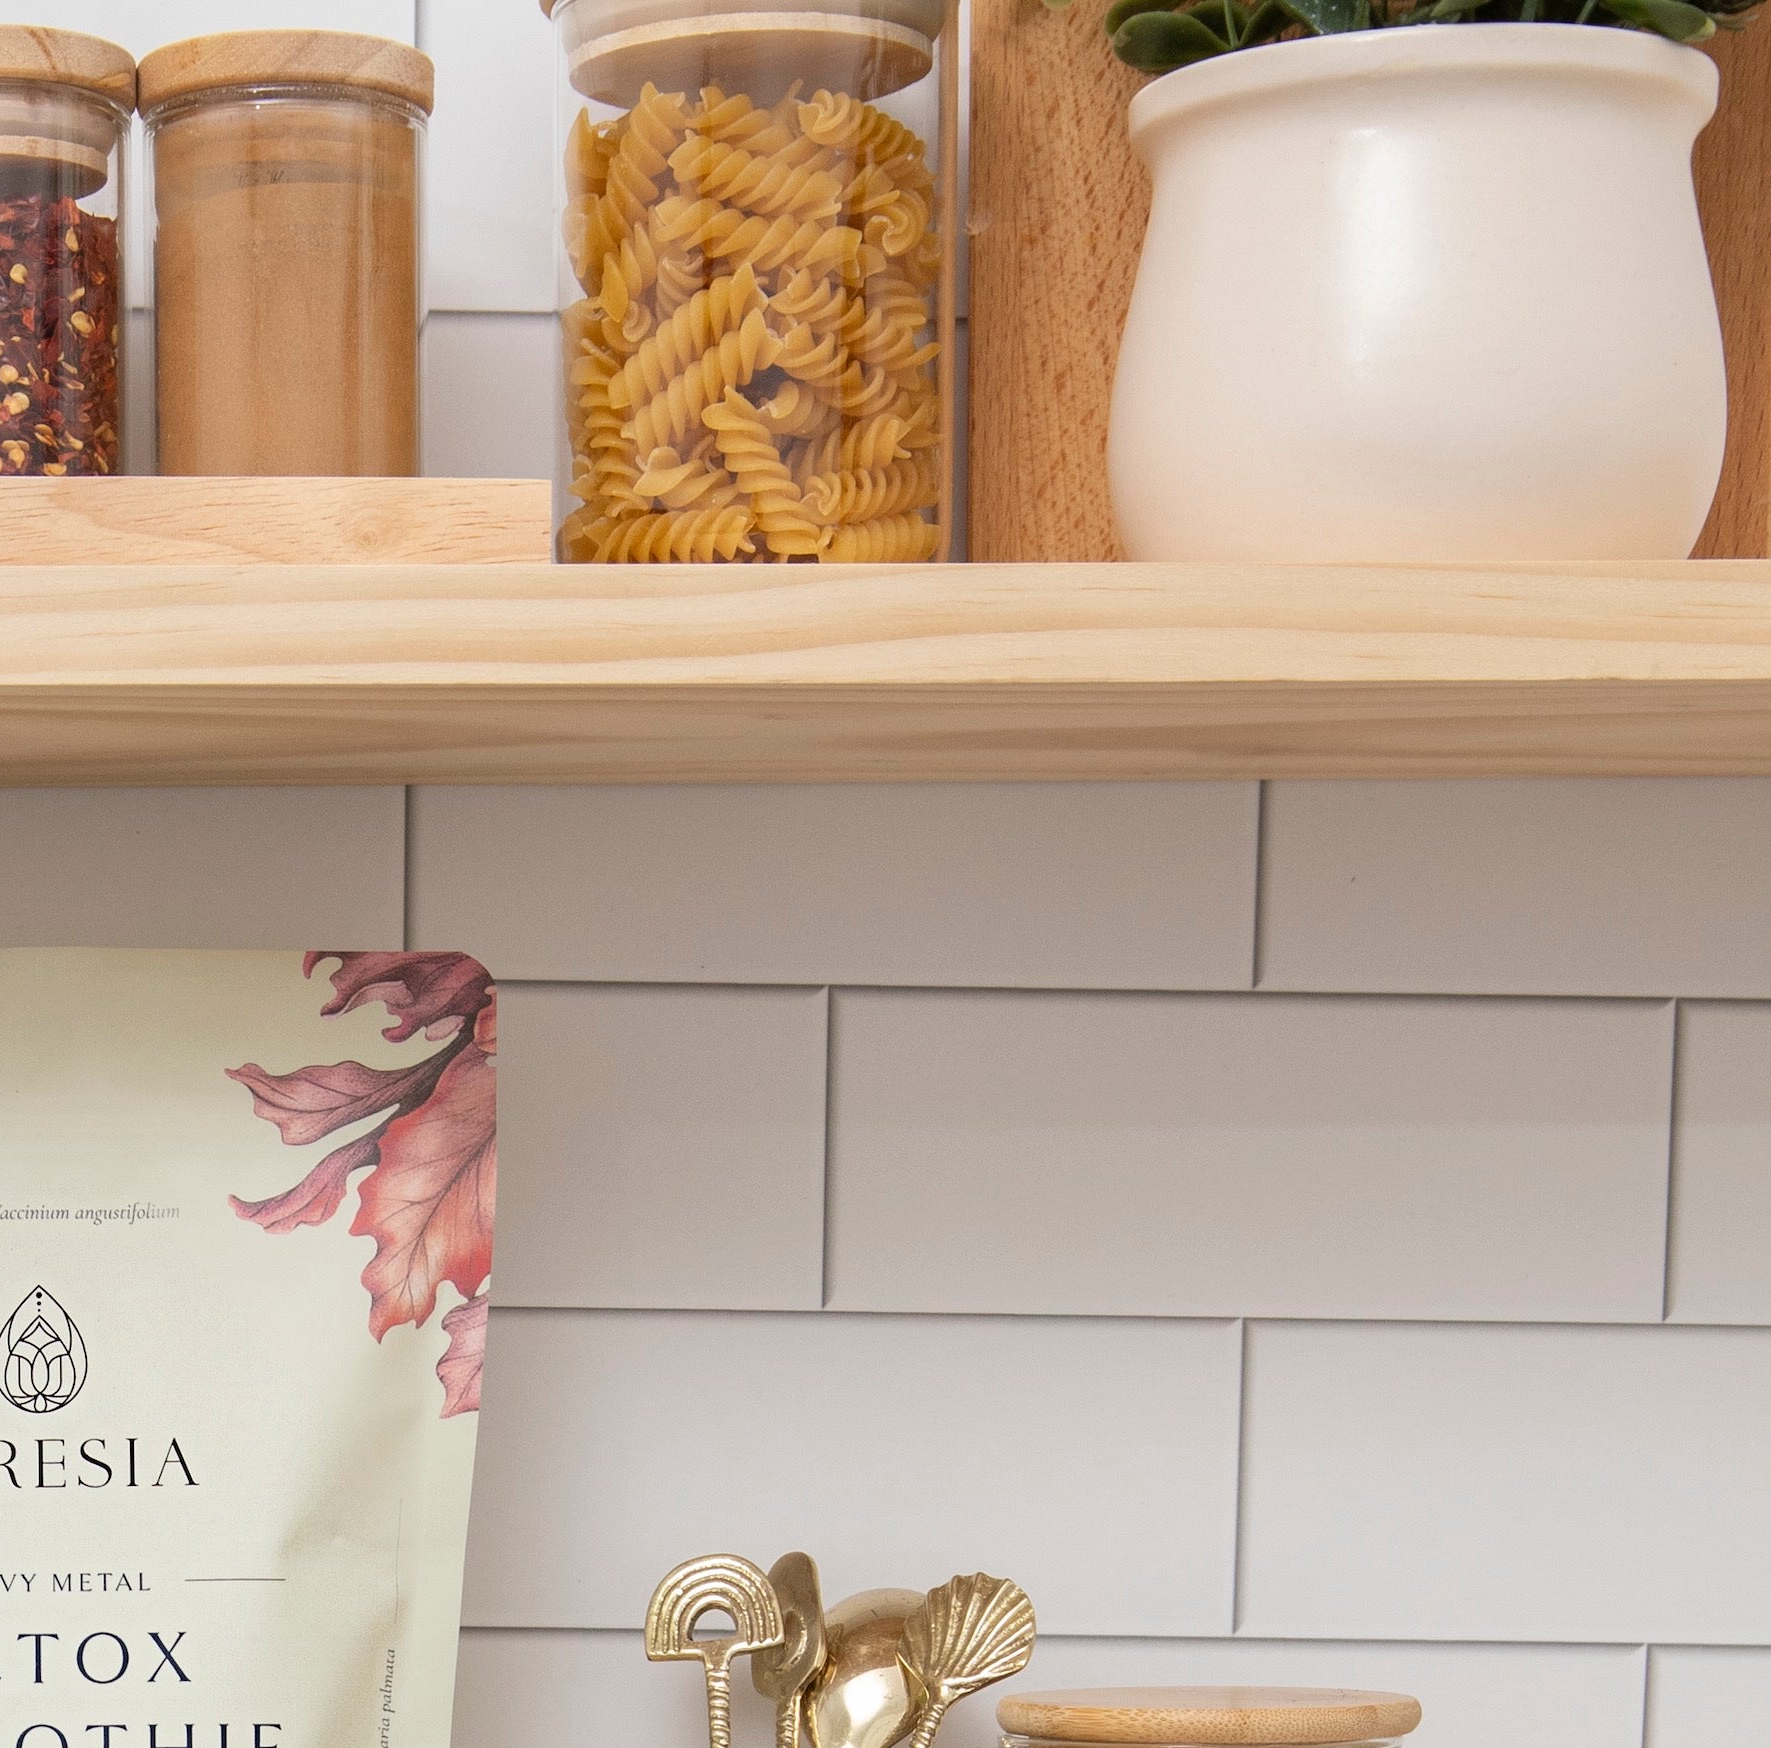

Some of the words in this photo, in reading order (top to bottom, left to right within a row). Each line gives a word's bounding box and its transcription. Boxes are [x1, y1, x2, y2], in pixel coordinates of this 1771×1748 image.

[74, 1202, 180, 1226] angustifolium
[52, 1572, 151, 1592] METAL
[378, 1648, 396, 1714] palmata
